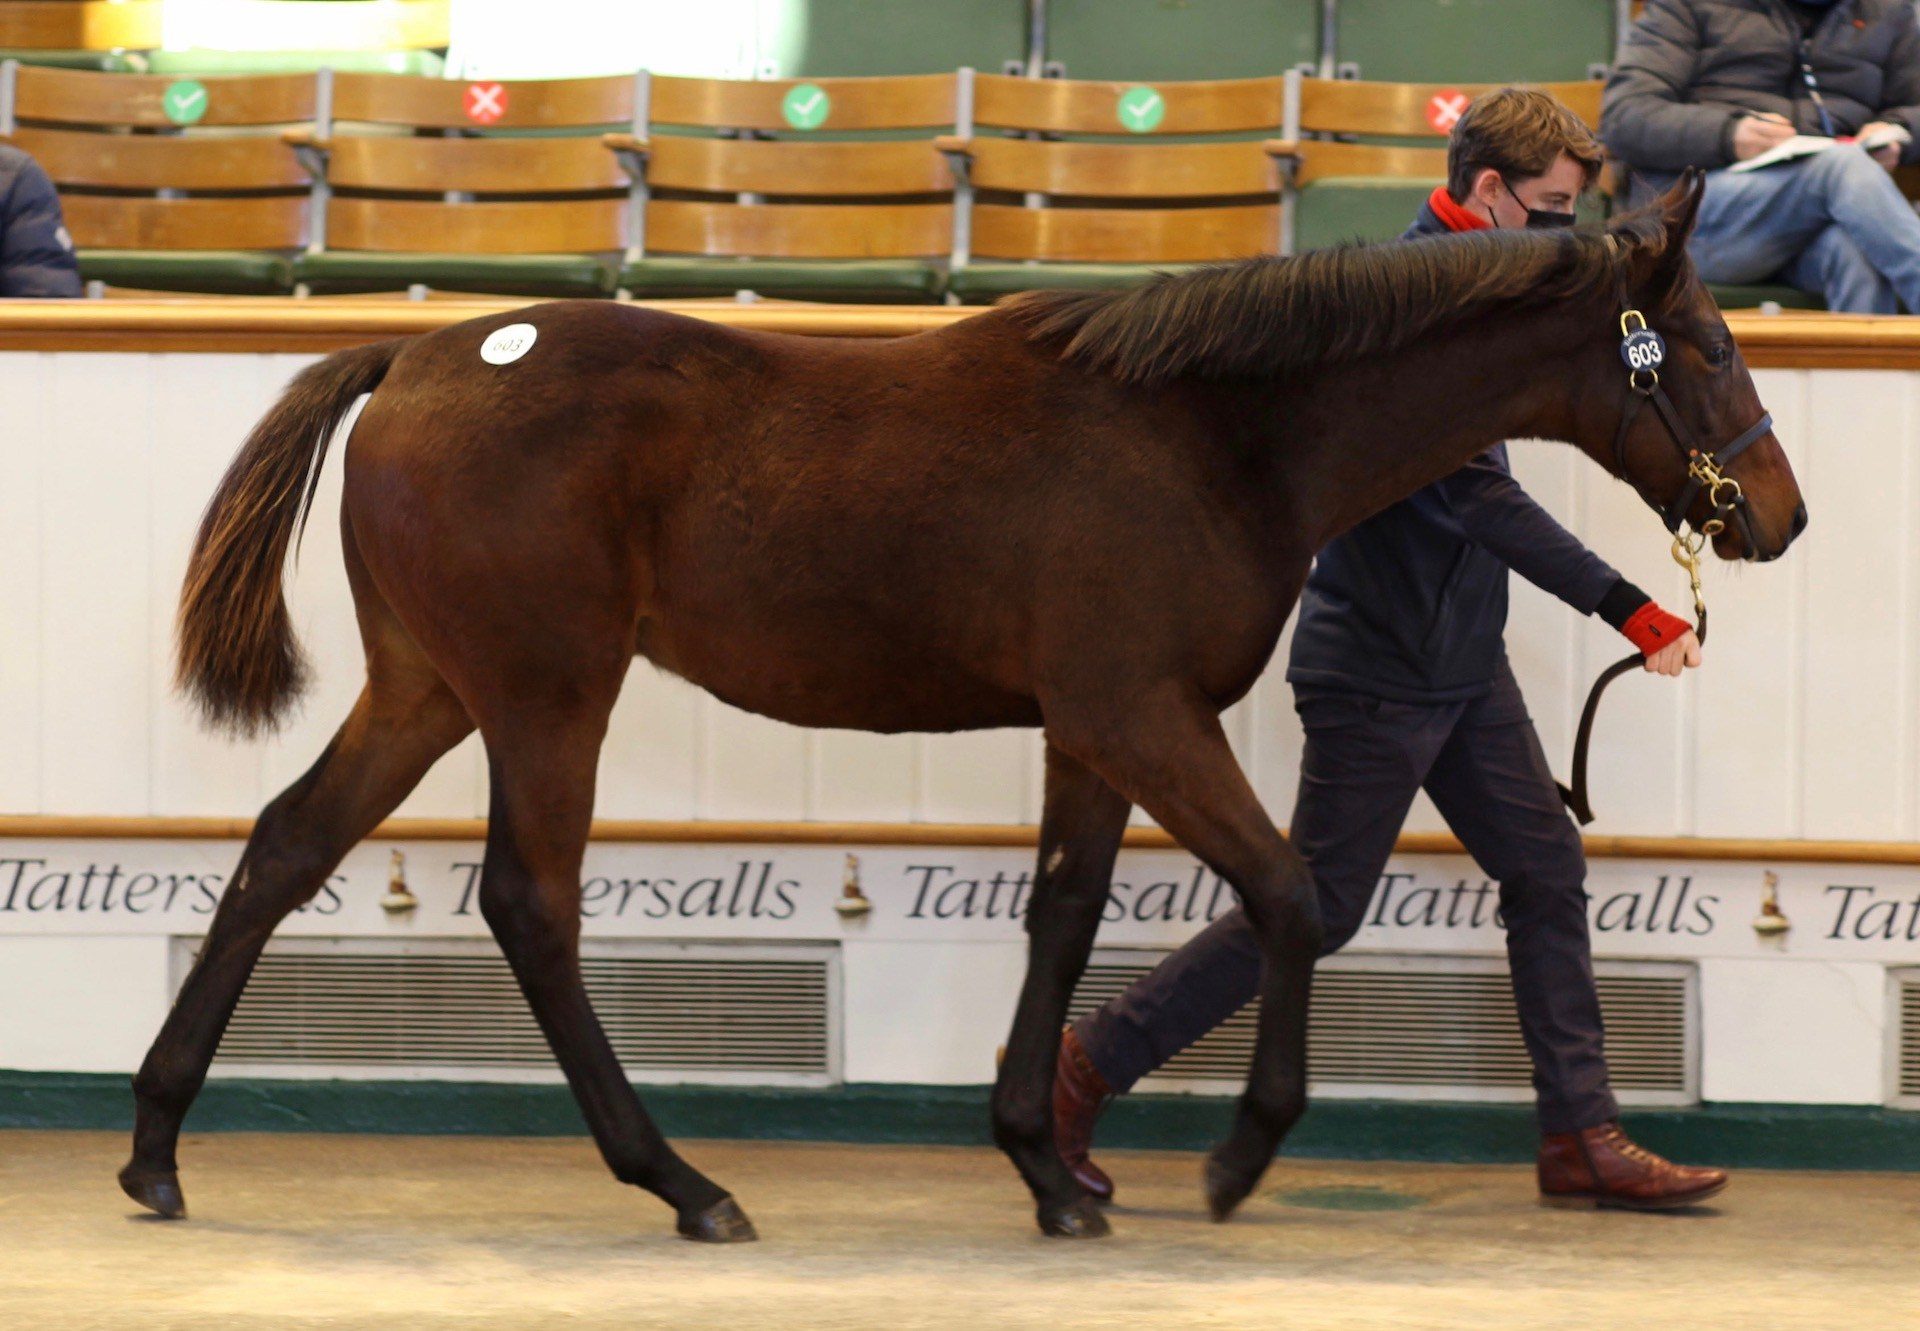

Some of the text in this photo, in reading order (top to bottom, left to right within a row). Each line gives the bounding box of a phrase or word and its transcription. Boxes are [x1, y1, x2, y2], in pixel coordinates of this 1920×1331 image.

[1628, 340, 1662, 369] 603
[0, 858, 347, 915] Tatterss
[450, 861, 801, 920] Tersalls
[905, 864, 1241, 923] Tattsall
[1368, 872, 1720, 936] Tattalls
